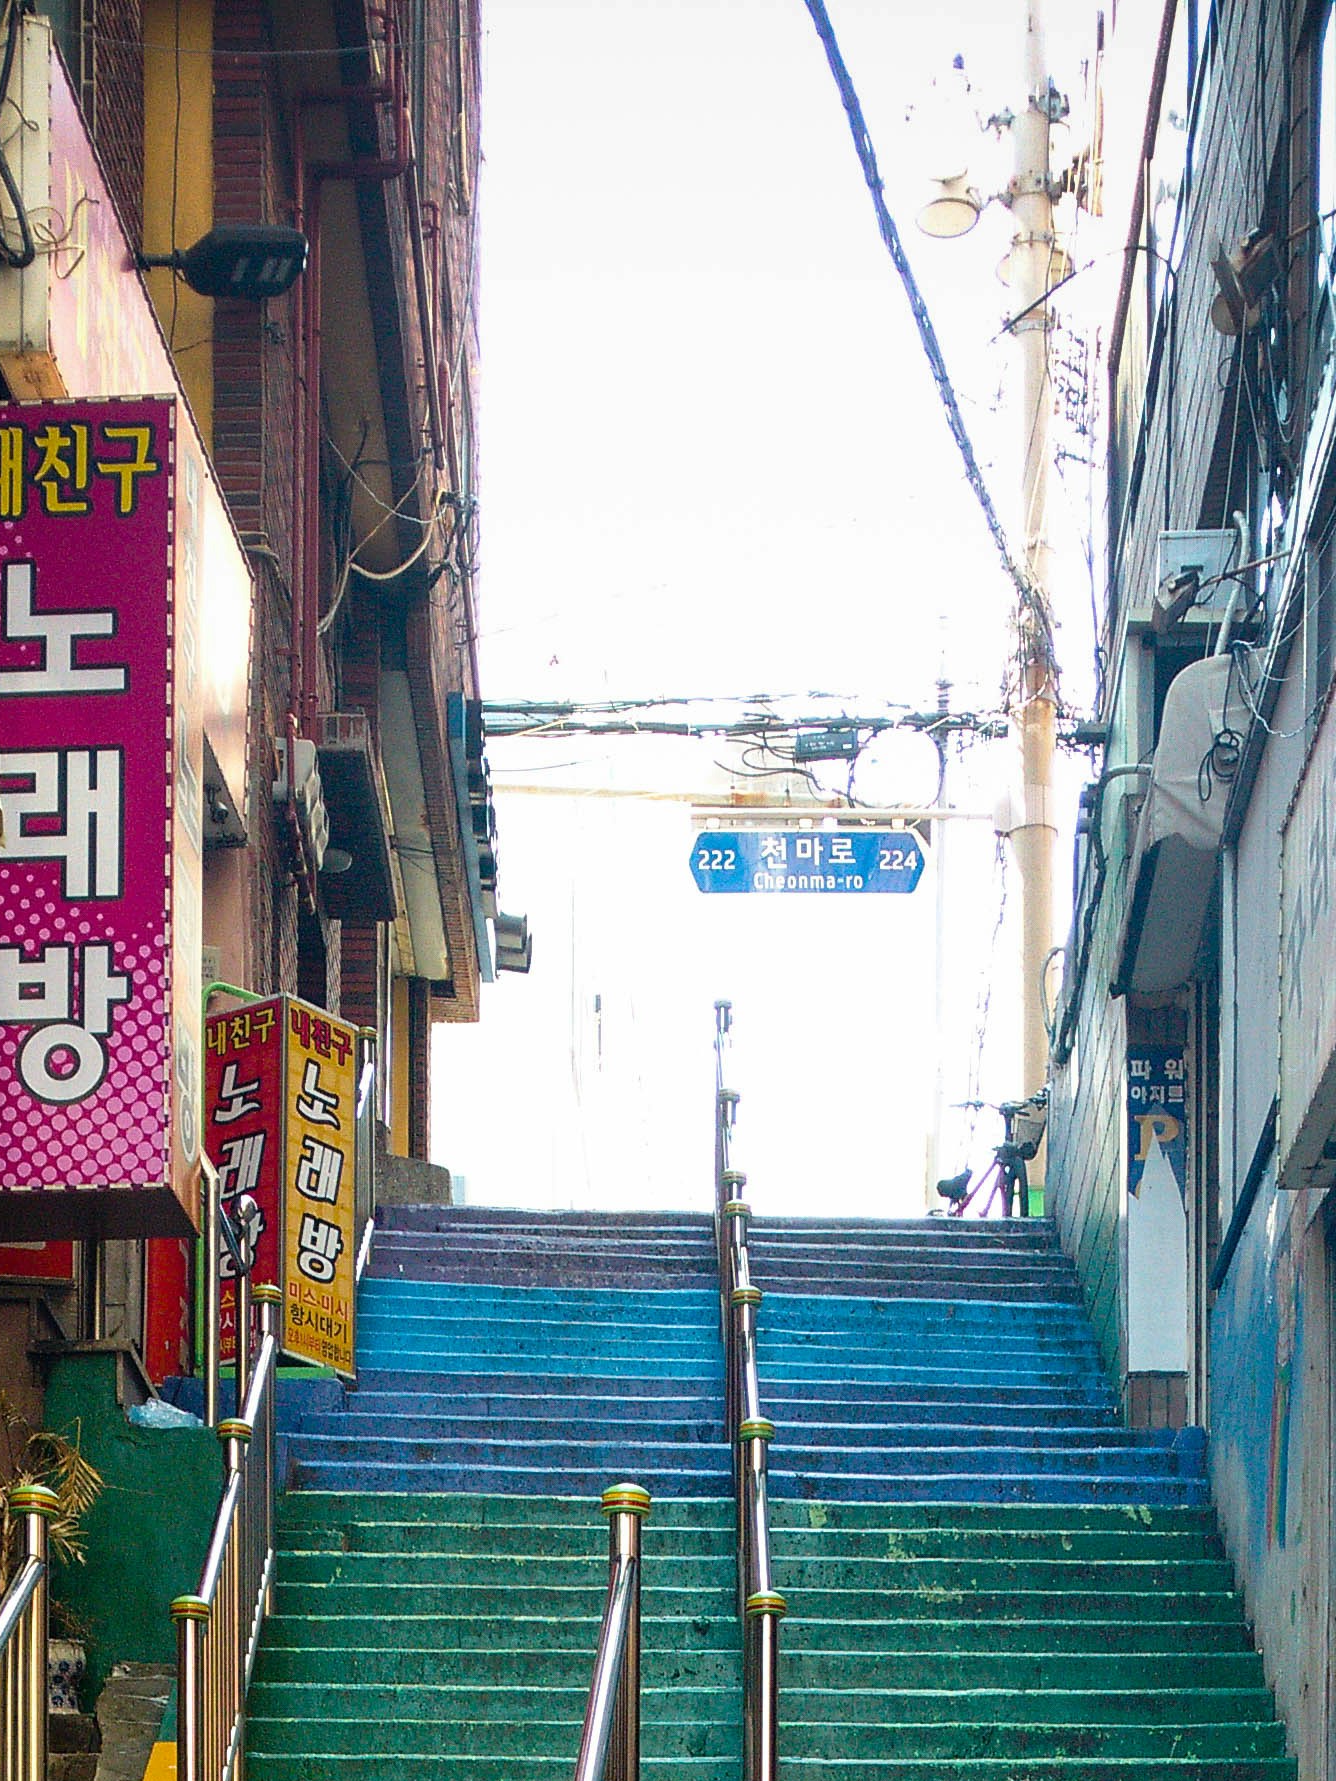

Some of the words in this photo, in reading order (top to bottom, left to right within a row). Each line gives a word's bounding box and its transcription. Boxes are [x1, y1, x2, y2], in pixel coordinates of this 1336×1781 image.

[698, 850, 736, 870] 222
[761, 837, 857, 869] 천마로
[879, 850, 918, 870] 224
[753, 873, 864, 889] Cheonma-ro
[205, 1005, 277, 1056] 내친구
[290, 1007, 354, 1066] 내친구
[1130, 1085, 1185, 1105] 아지트
[295, 1057, 345, 1284] 노래방
[290, 1303, 348, 1344] 항시대기
